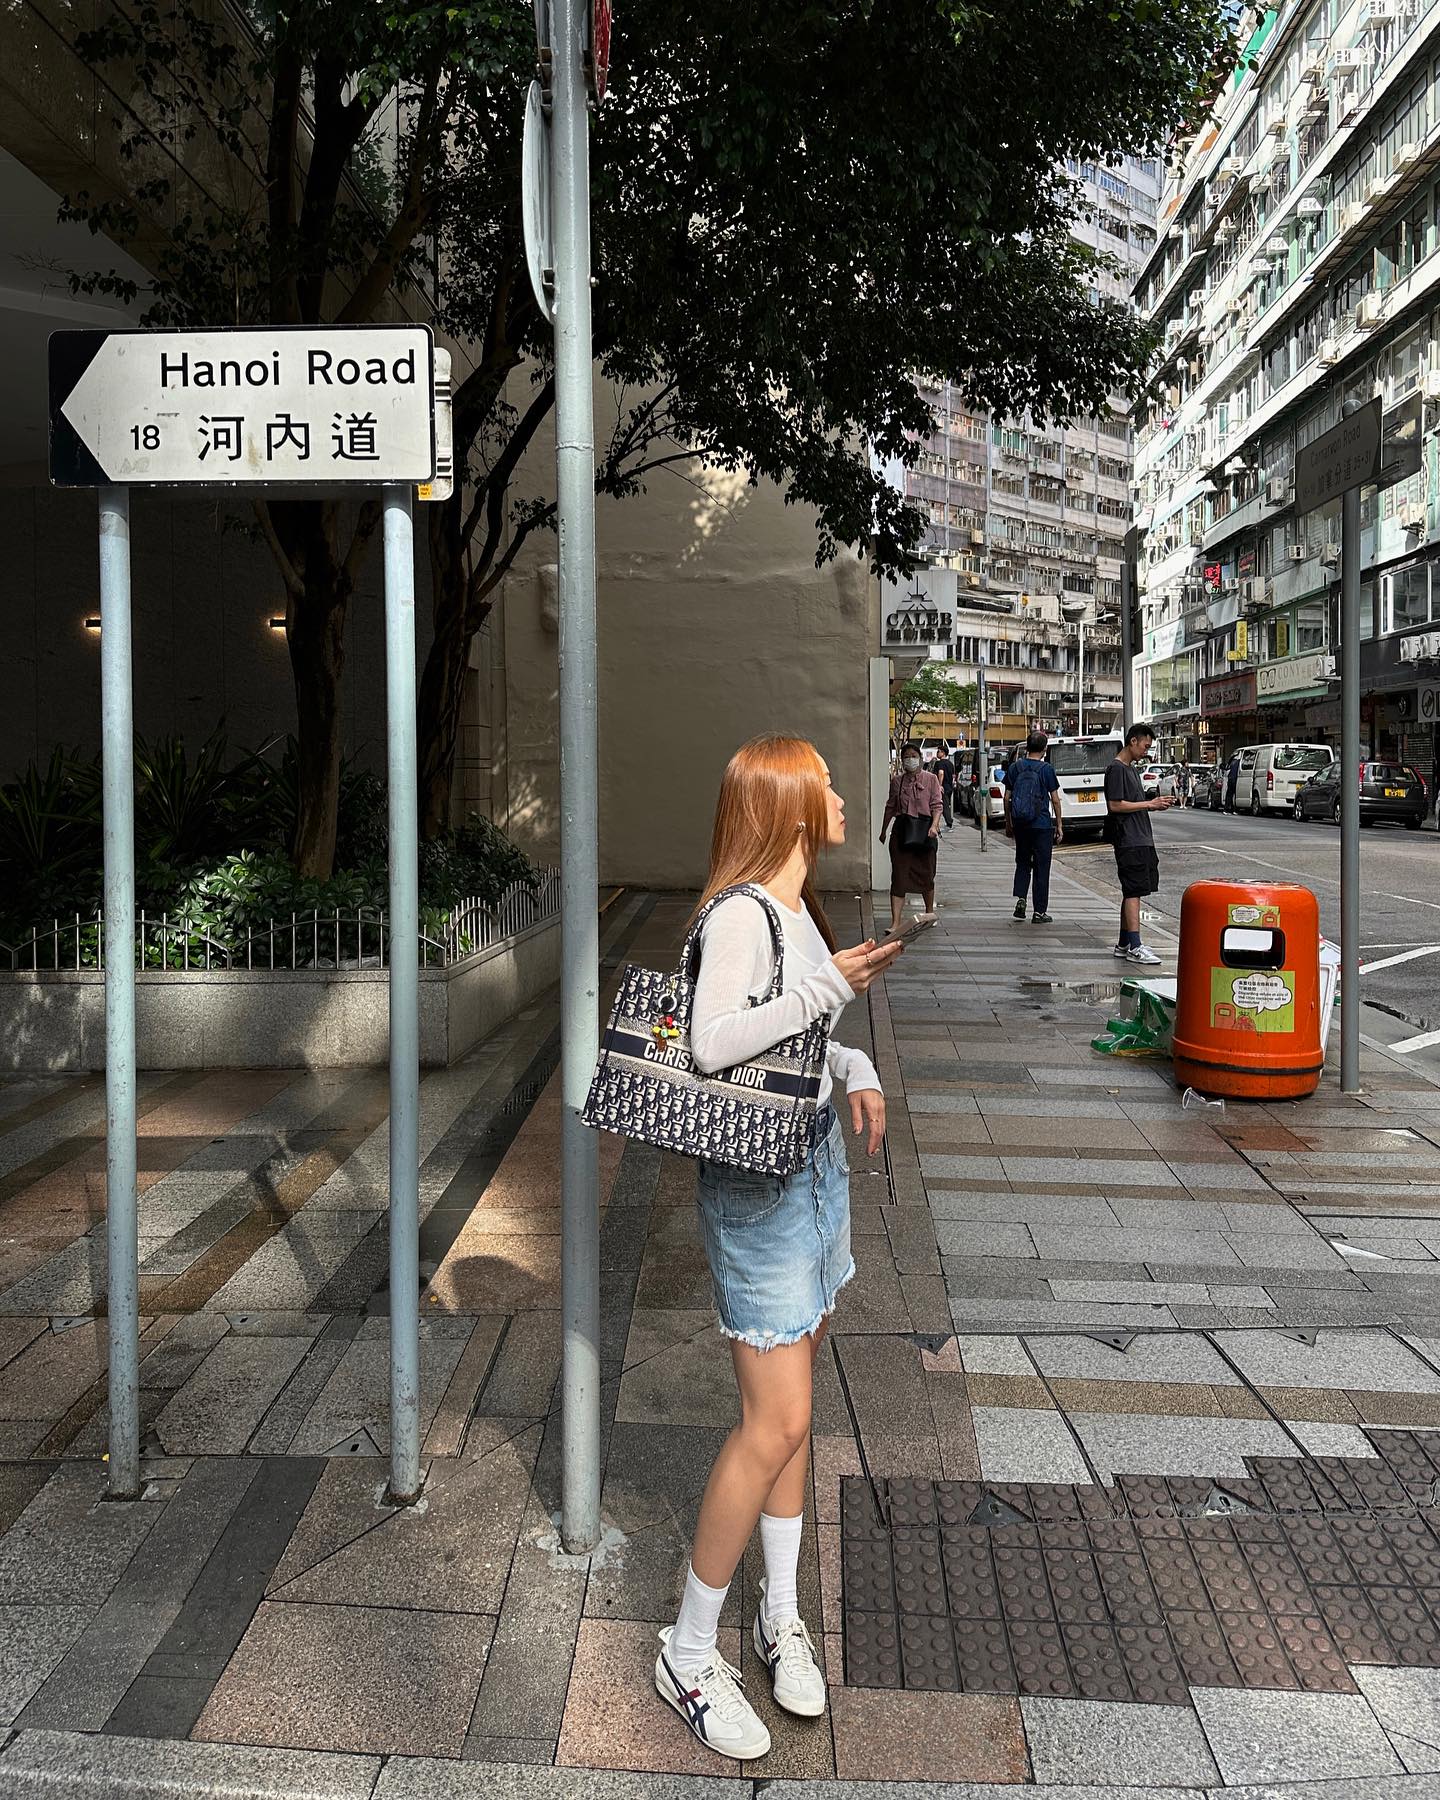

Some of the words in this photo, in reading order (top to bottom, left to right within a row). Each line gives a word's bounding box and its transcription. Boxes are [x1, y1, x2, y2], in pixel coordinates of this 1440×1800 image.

[160, 351, 280, 388] Hanoi
[307, 348, 416, 386] Road
[130, 424, 161, 451] 18
[197, 411, 381, 462] 河內道
[1343, 420, 1361, 448] Road
[886, 612, 953, 627] CALEB
[730, 1066, 767, 1090] DIOR
